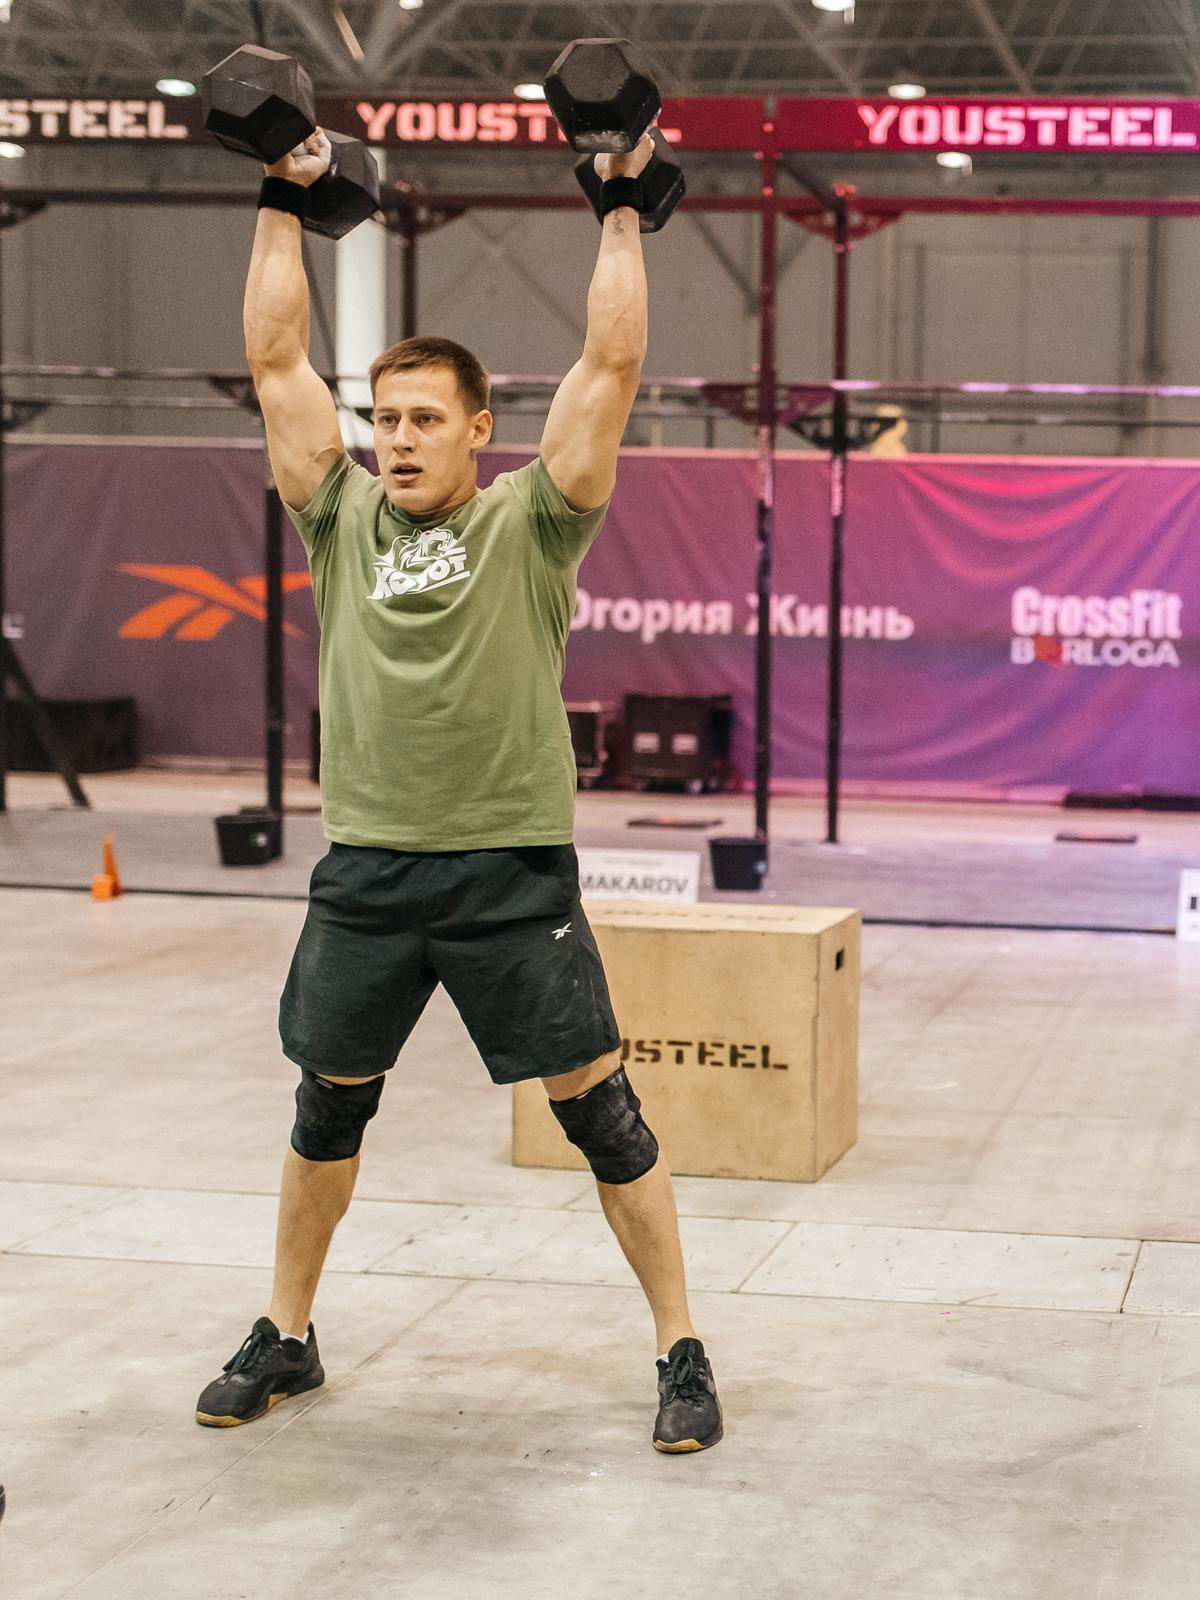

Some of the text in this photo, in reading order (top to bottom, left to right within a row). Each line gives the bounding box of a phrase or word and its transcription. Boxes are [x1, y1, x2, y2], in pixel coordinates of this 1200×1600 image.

[356, 102, 682, 143] YOUST
[857, 105, 1197, 146] YOUSTEEL
[745, 592, 915, 641] Жинь
[1011, 585, 1182, 638] CrossFit
[1010, 636, 1181, 668] BRLOGA
